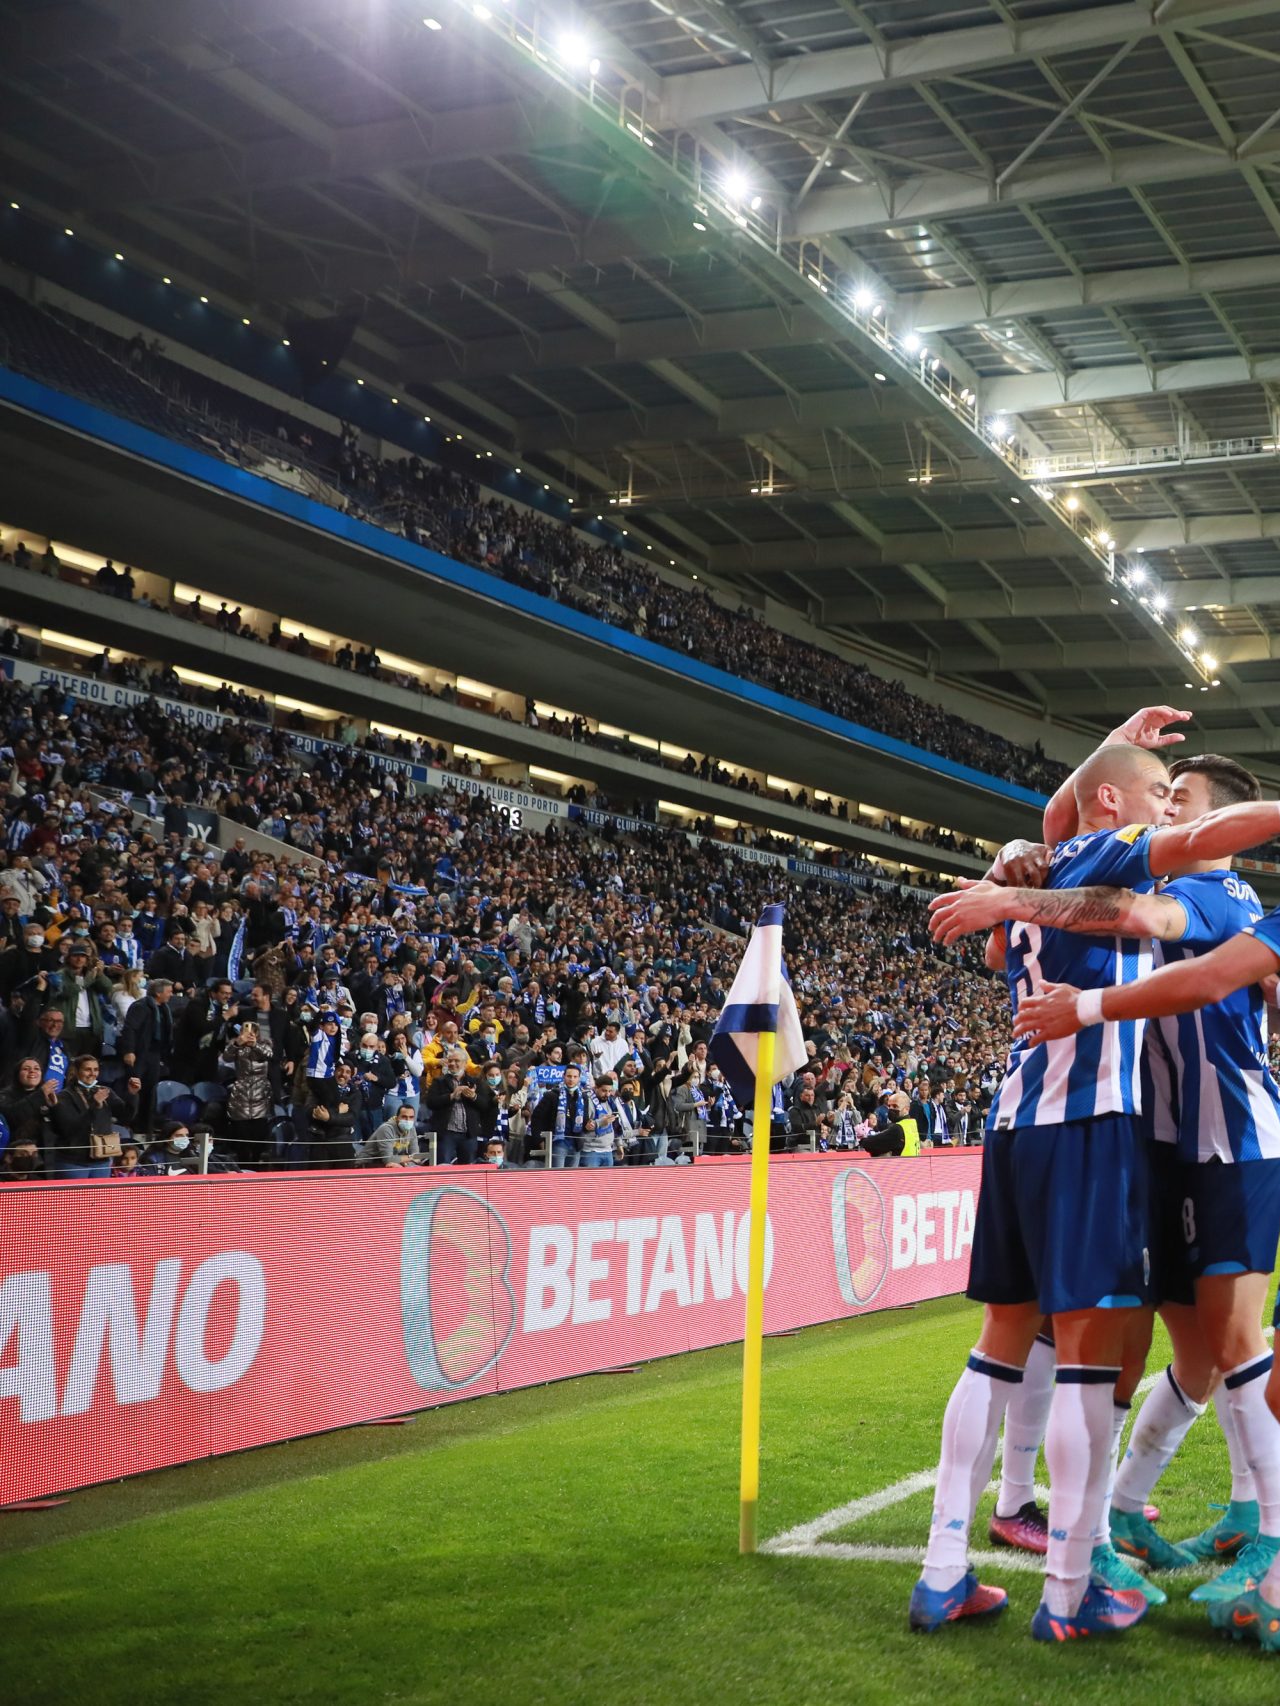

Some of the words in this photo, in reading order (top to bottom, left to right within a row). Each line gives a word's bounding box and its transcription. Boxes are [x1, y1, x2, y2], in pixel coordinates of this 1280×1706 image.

[187, 709, 231, 730] PORT
[486, 786, 515, 804] CLUBE
[516, 793, 529, 806] DO
[531, 796, 560, 814] PORTO
[538, 1068, 550, 1079] FC
[522, 1208, 775, 1334] BETANO
[0, 1250, 267, 1424] ANO
